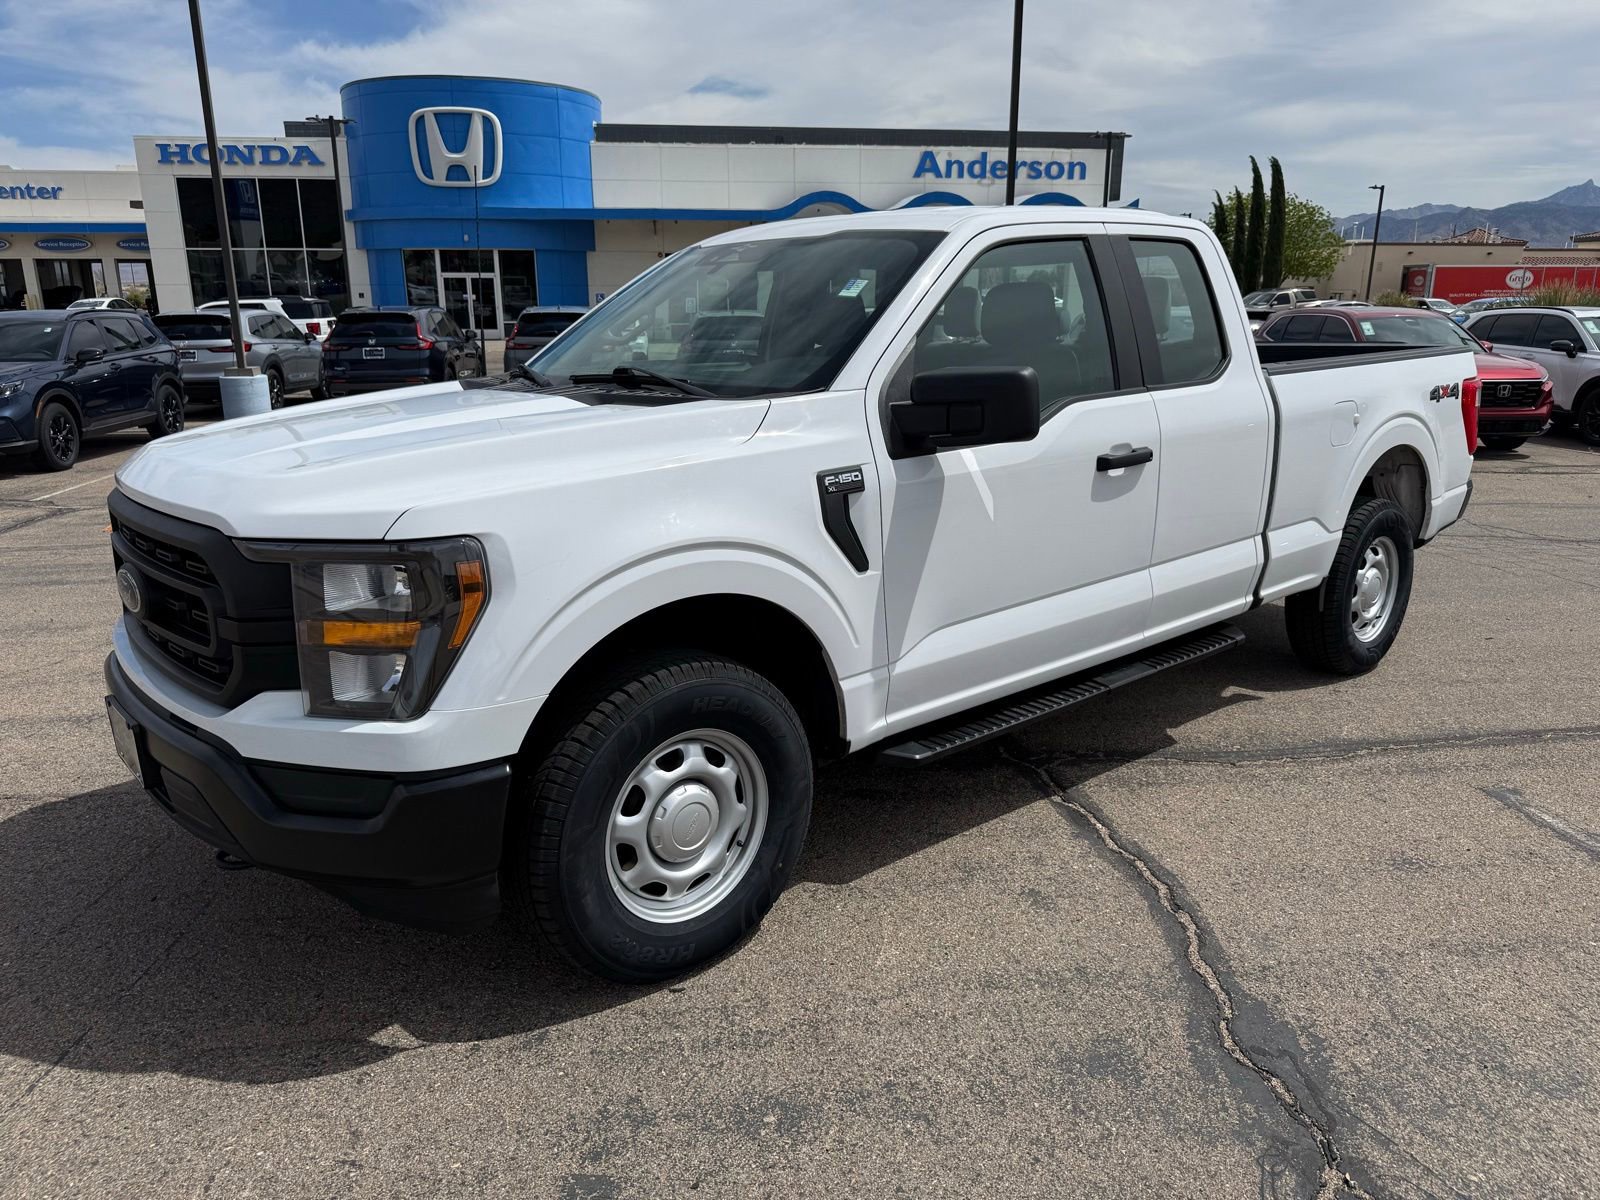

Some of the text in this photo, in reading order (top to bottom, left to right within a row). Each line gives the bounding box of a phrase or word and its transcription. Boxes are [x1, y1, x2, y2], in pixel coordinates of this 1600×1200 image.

[155, 143, 325, 166] HONDA
[912, 150, 1087, 180] Anderson
[1509, 273, 1531, 282] Greo
[824, 472, 862, 486] F-150
